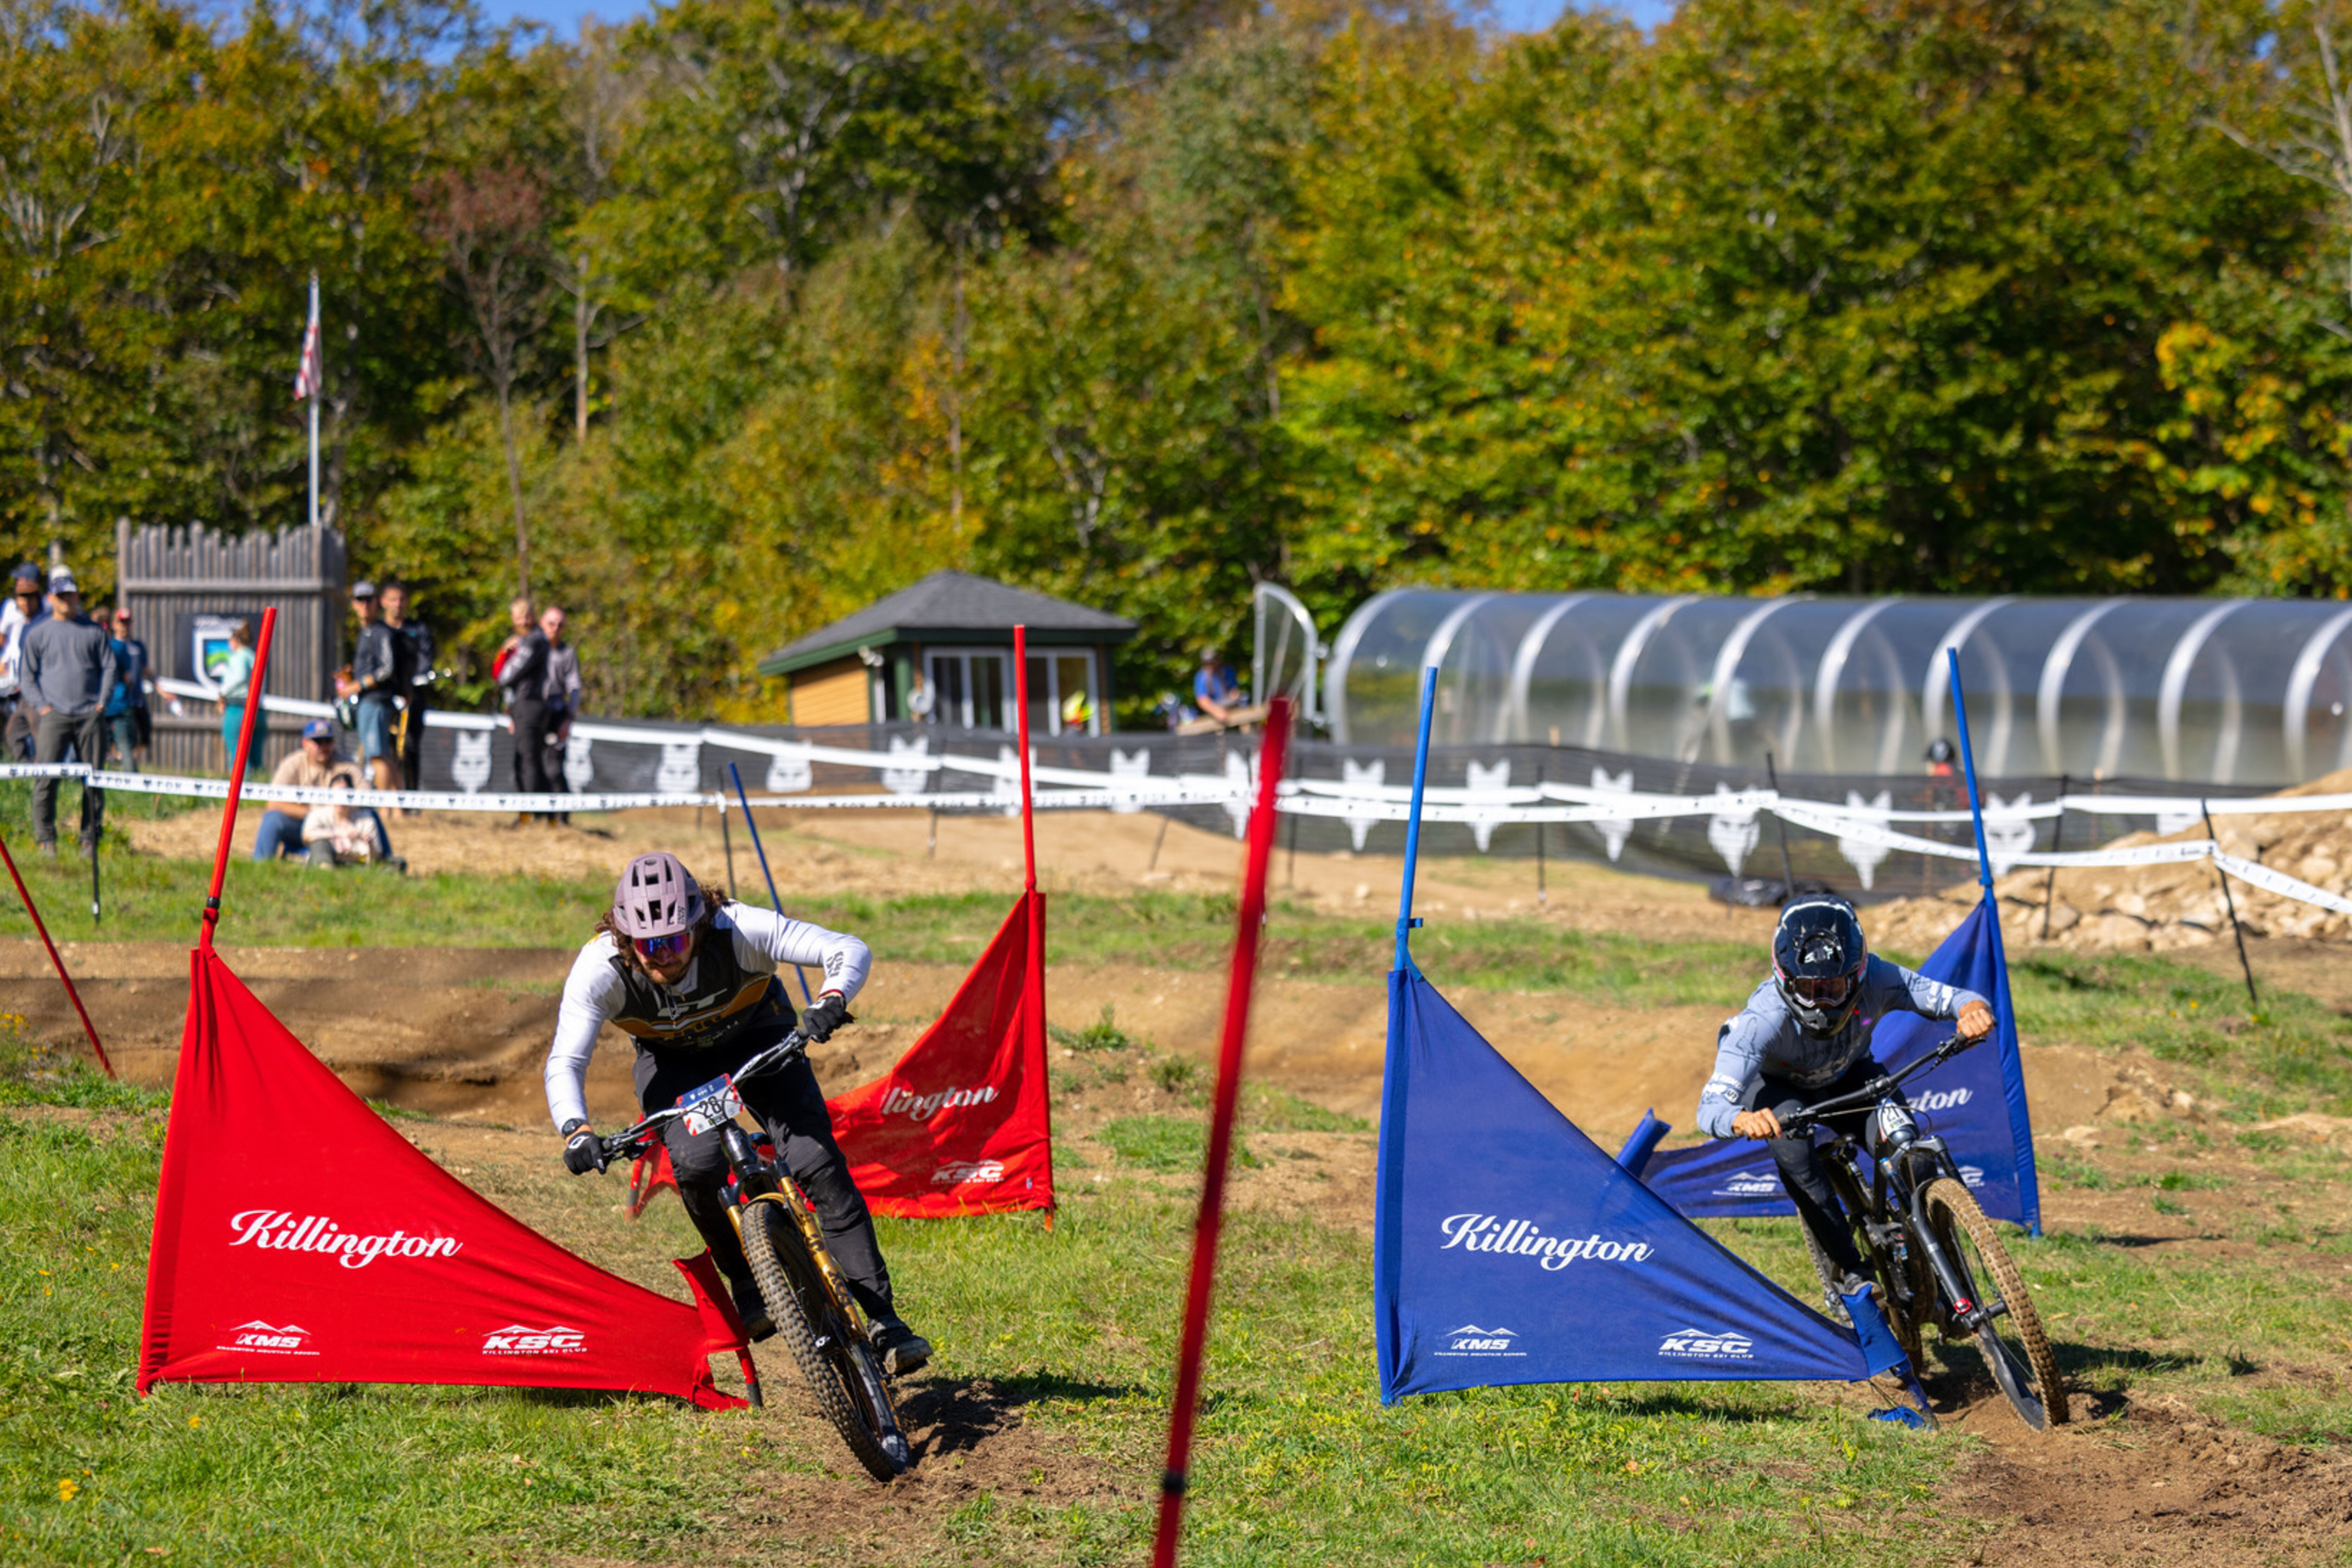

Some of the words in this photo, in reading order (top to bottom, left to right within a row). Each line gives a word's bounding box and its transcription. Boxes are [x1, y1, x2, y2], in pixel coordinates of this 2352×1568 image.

[75, 769, 90, 777] FO
[699, 1096, 722, 1118] 28
[229, 1210, 463, 1269] Killington
[1441, 1213, 1654, 1271] Killington
[235, 1333, 302, 1348] KMS
[483, 1335, 585, 1349] KSC
[1451, 1339, 1510, 1350] KMS
[1659, 1338, 1752, 1354] KSC
